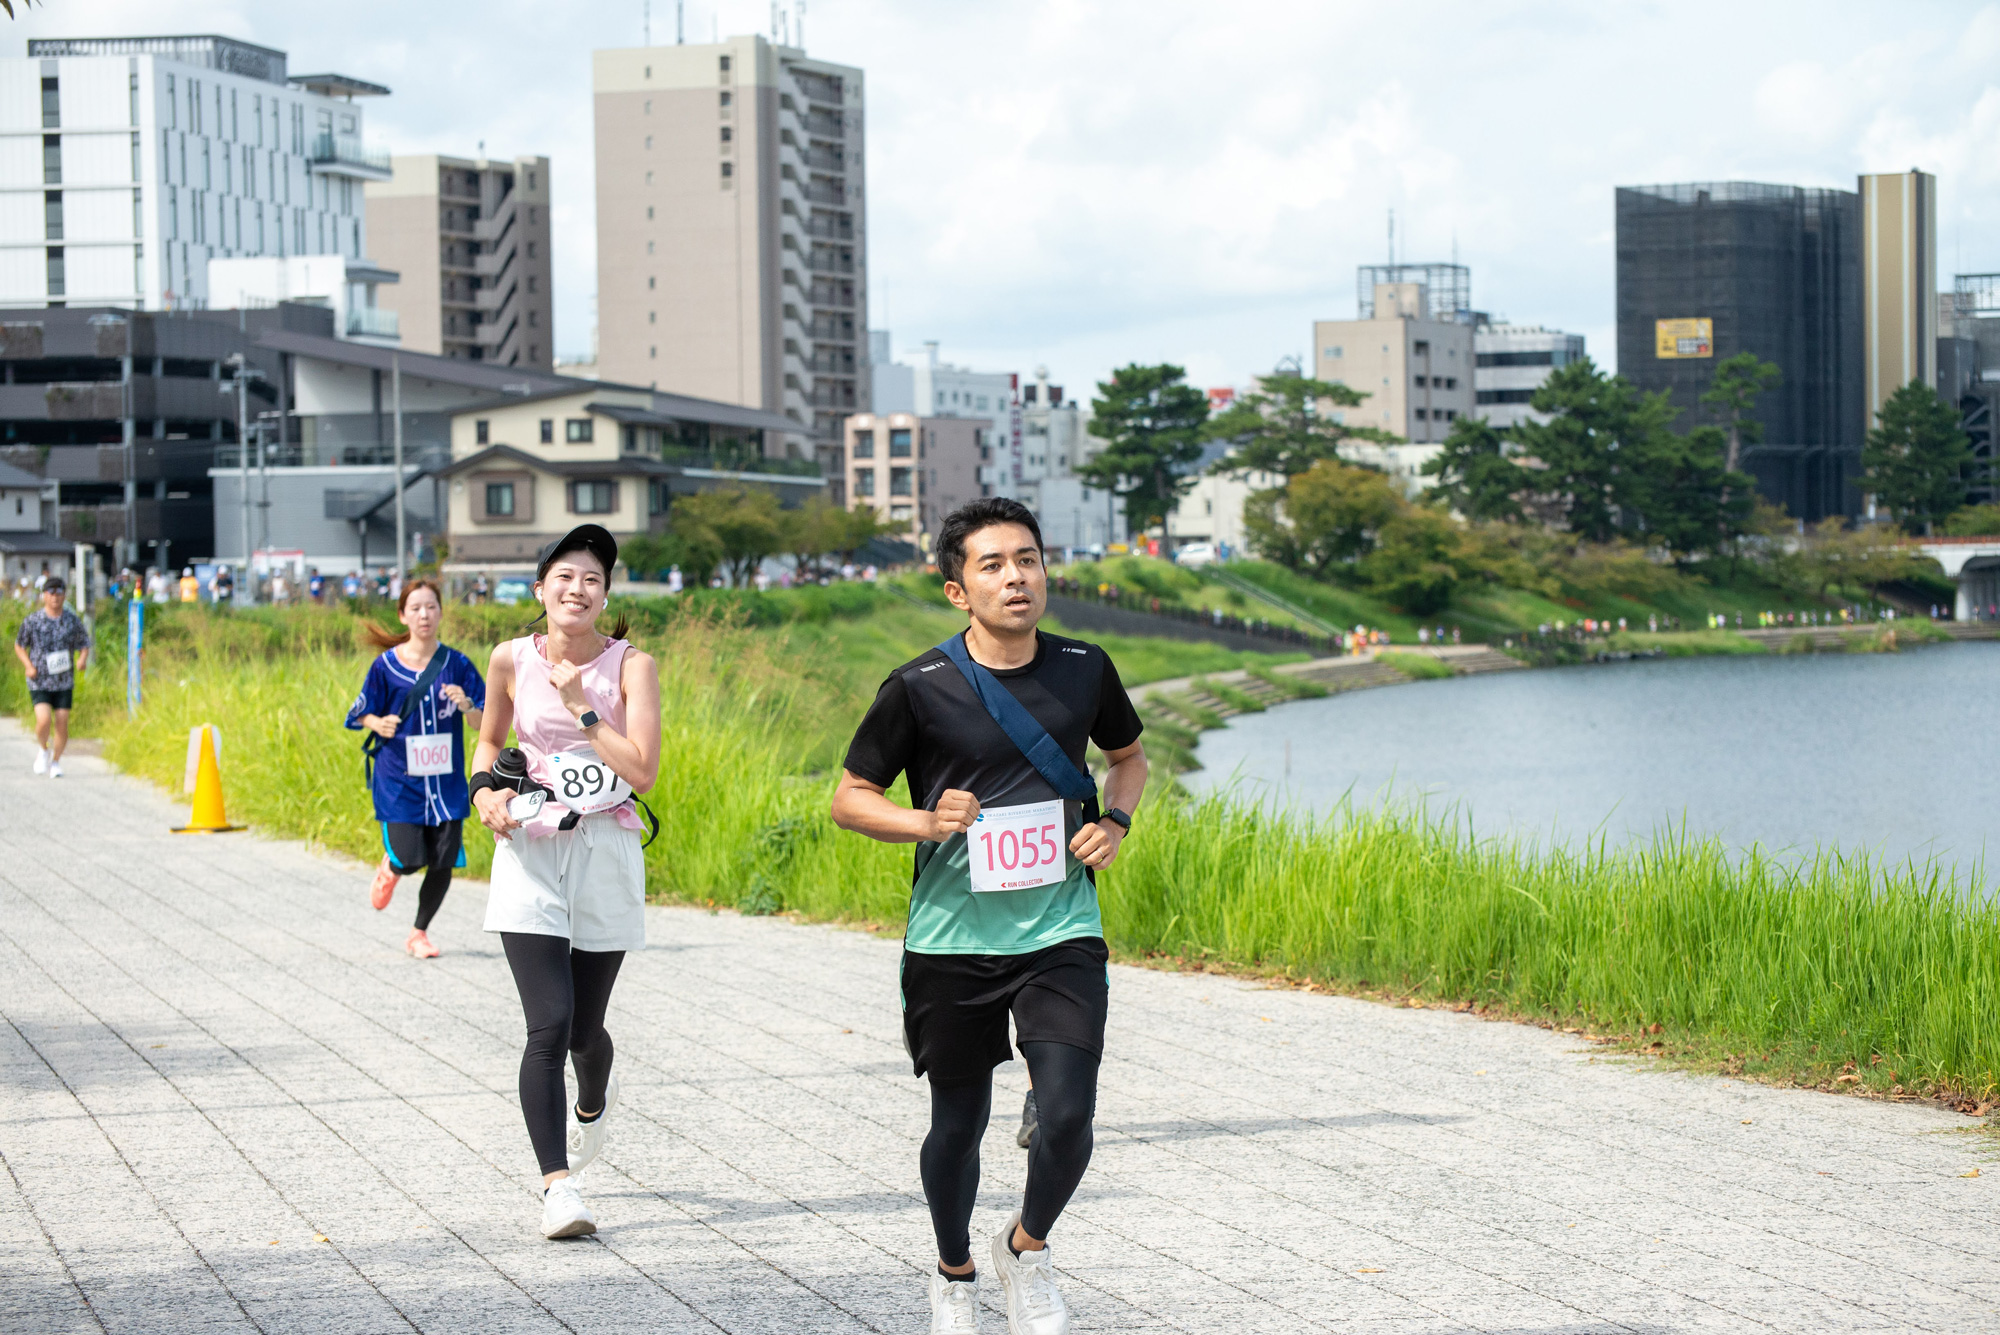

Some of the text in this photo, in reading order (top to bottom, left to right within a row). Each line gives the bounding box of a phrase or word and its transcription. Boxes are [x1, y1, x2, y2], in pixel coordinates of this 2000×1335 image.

[412, 744, 449, 767] 1060
[980, 824, 1056, 871] 1055
[1018, 878, 1043, 887] COLLECTION
